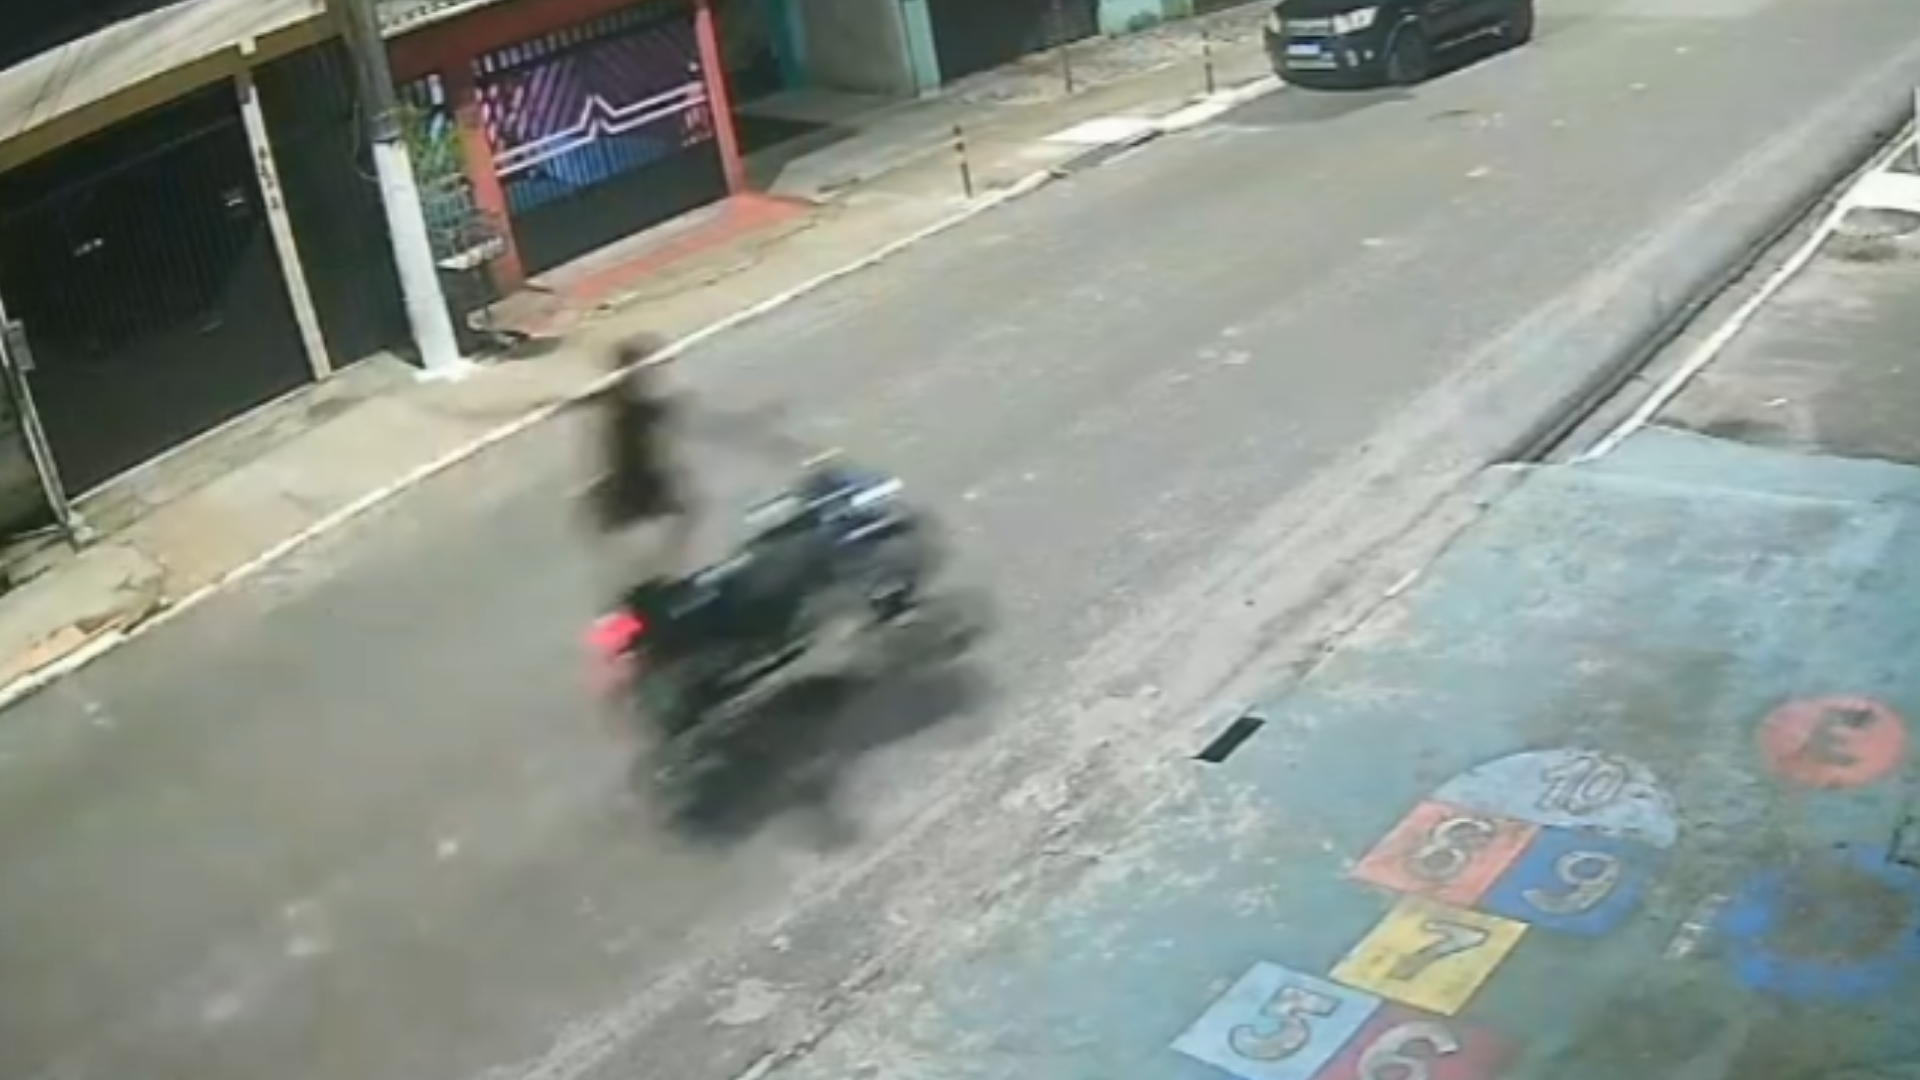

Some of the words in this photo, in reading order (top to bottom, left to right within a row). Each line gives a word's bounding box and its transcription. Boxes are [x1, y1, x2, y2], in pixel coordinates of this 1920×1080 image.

[1538, 753, 1625, 813] 10
[1522, 850, 1617, 914] 9
[1390, 920, 1489, 981] 7
[1229, 985, 1339, 1060] 5
[1358, 1022, 1457, 1080] 6
